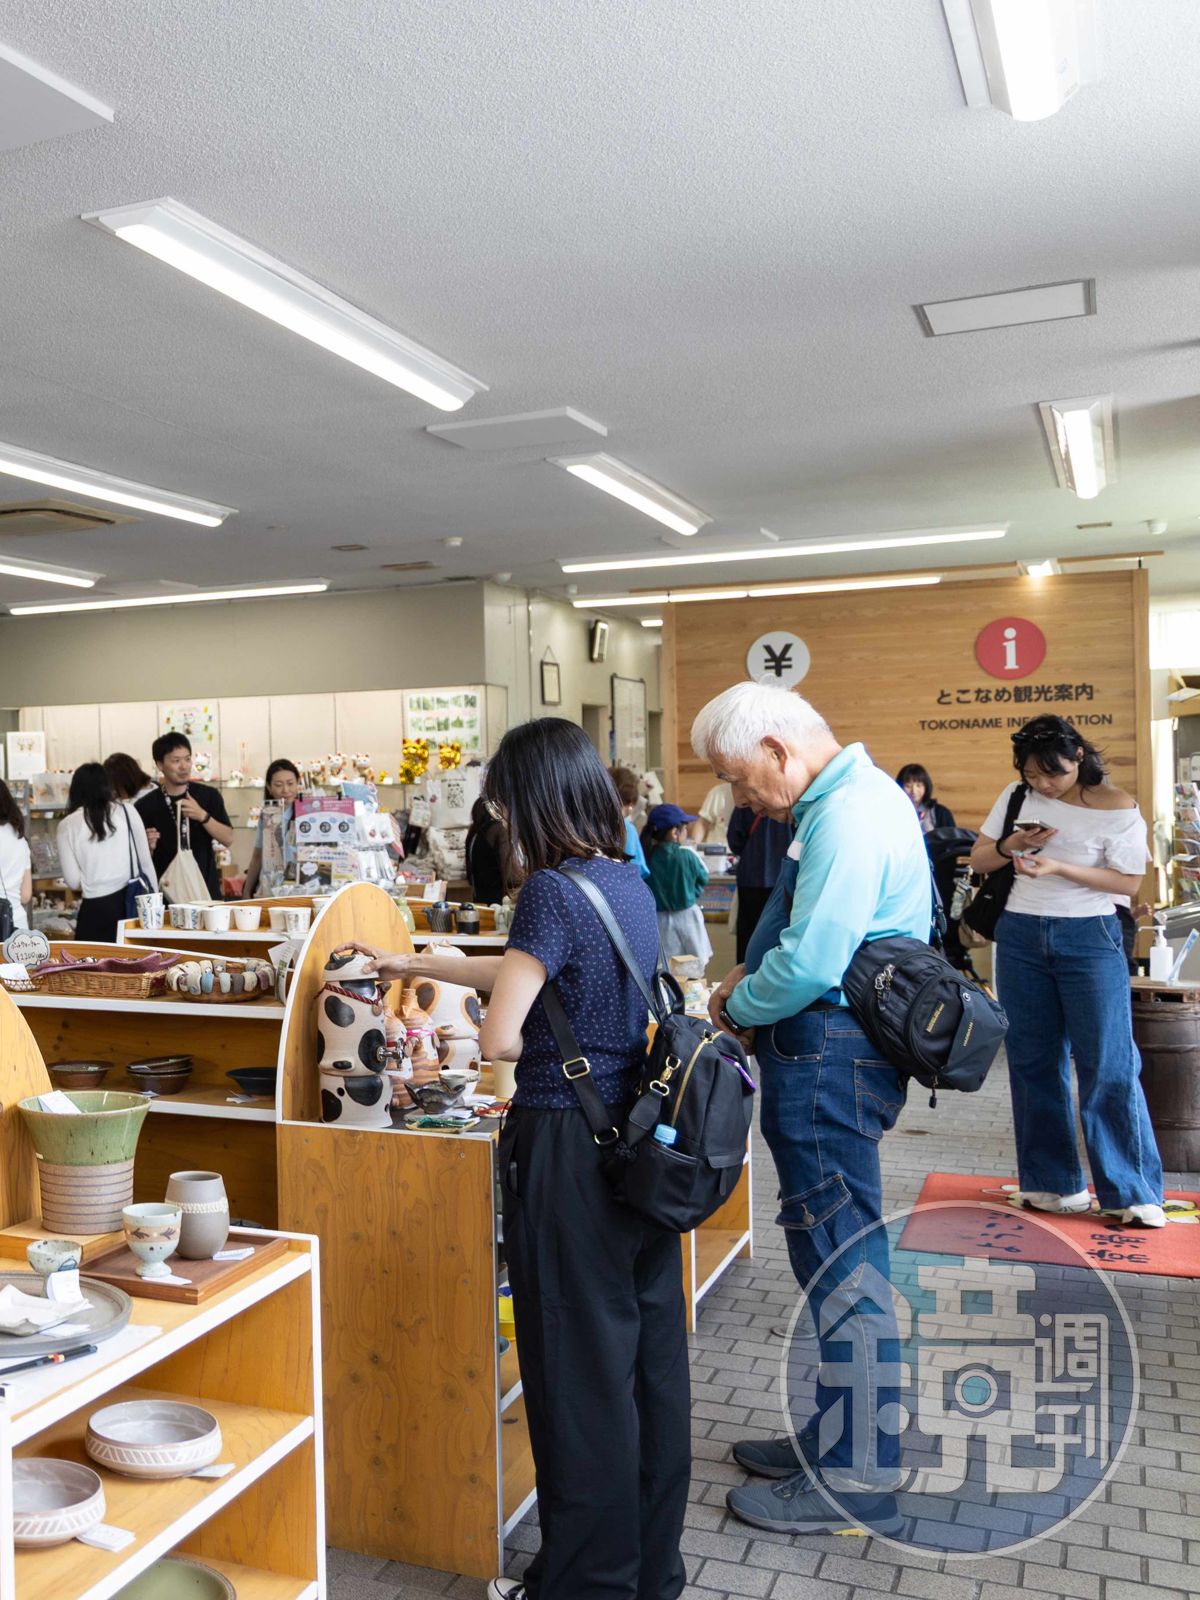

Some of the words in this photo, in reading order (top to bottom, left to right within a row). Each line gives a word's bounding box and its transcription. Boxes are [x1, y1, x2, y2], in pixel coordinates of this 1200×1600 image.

[936, 683, 1094, 705] とこなめ観光案内
[919, 717, 1002, 731] TOKONAME
[1007, 713, 1113, 729] INFATION
